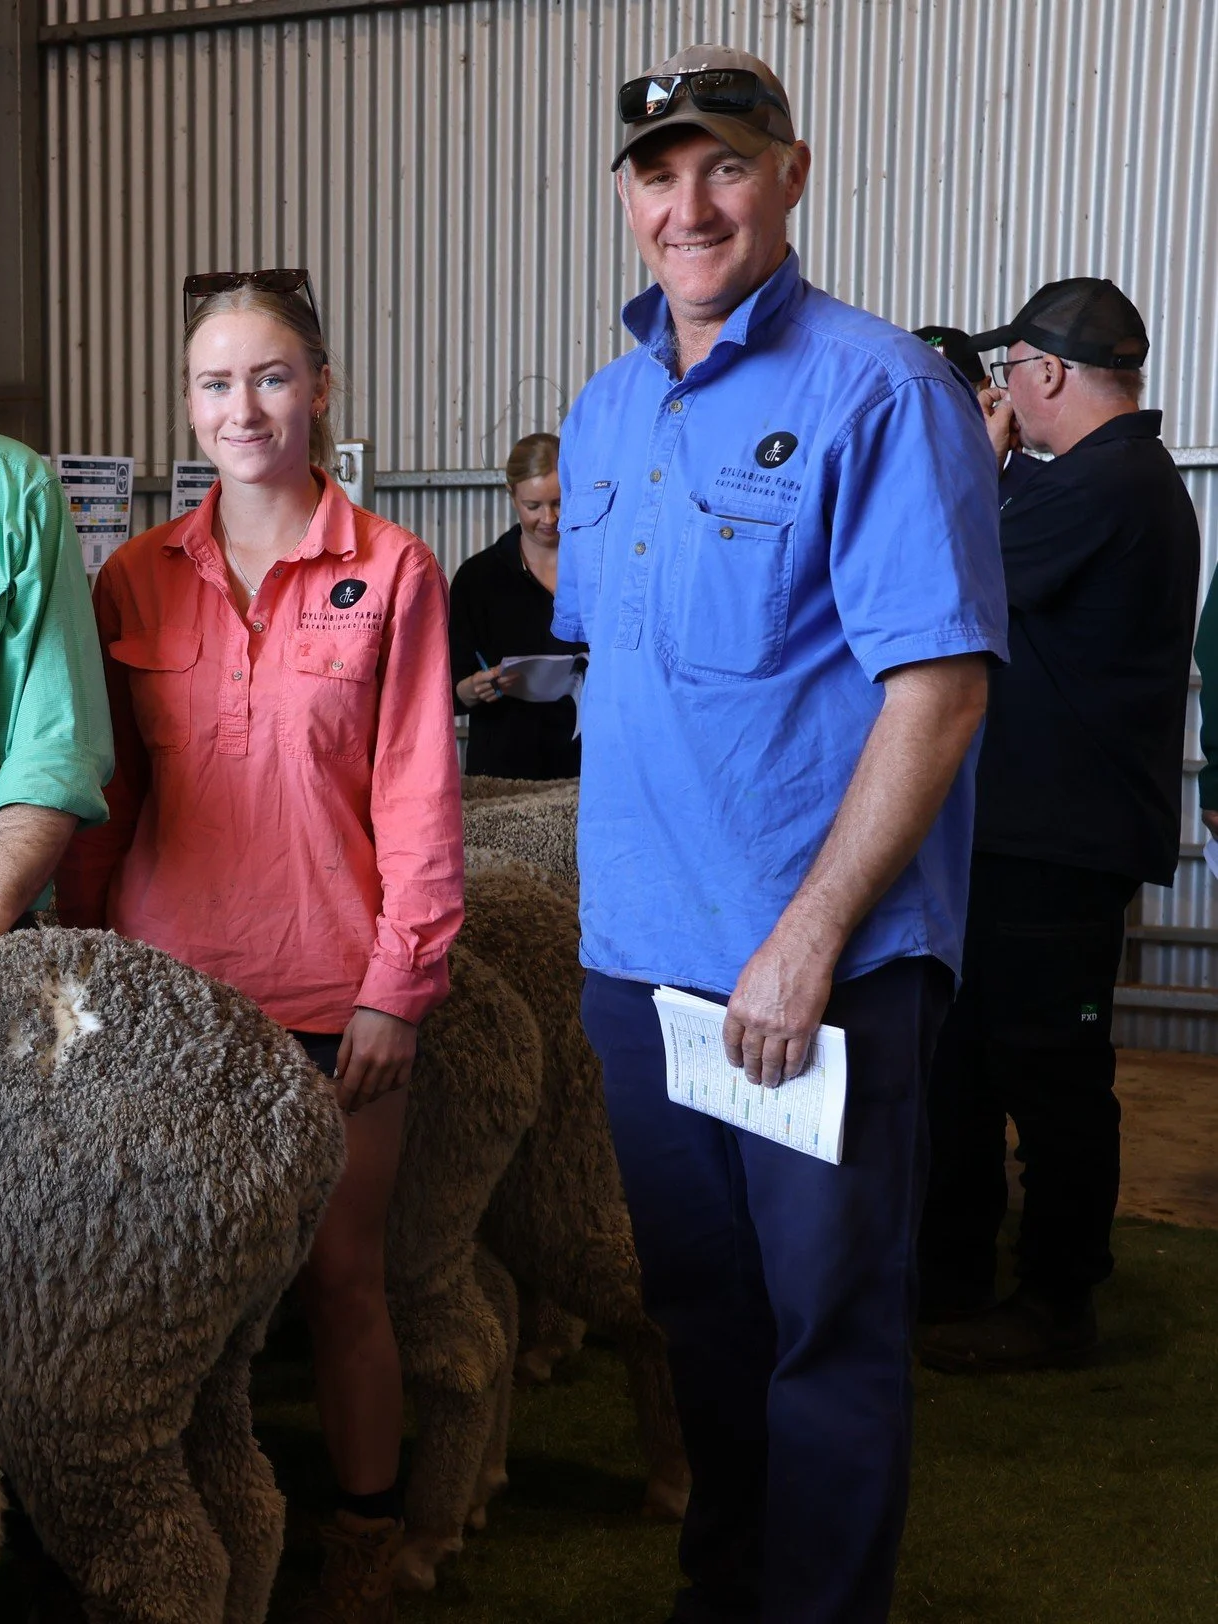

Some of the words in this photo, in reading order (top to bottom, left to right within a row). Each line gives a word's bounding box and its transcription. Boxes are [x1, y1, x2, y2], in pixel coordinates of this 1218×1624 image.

[715, 479, 775, 496] ESTABLISHED
[354, 611, 382, 621] FARMS
[1081, 1013, 1098, 1022] FXD
